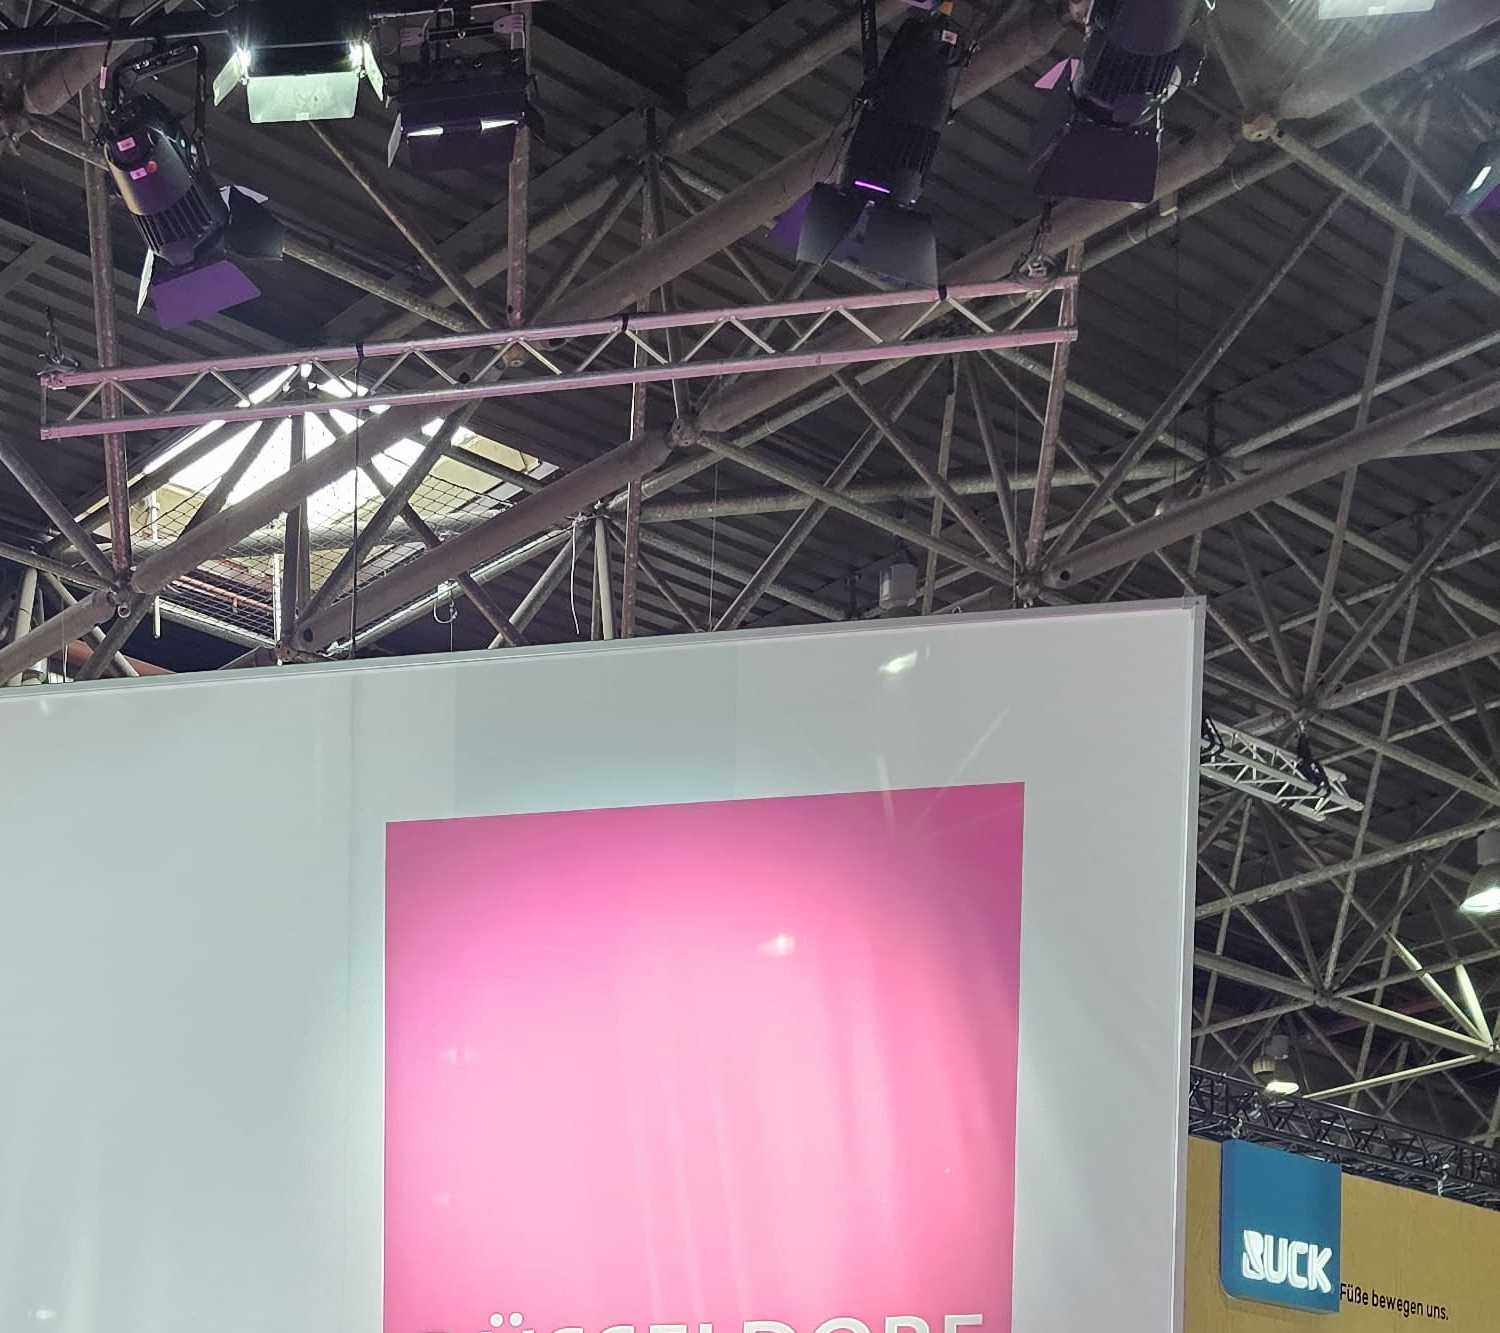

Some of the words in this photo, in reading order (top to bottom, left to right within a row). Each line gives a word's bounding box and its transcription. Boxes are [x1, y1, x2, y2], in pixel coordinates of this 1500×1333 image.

[1340, 1283, 1369, 1306] Füße
[1372, 1289, 1423, 1318] bewegen
[1426, 1304, 1449, 1321] uns.
